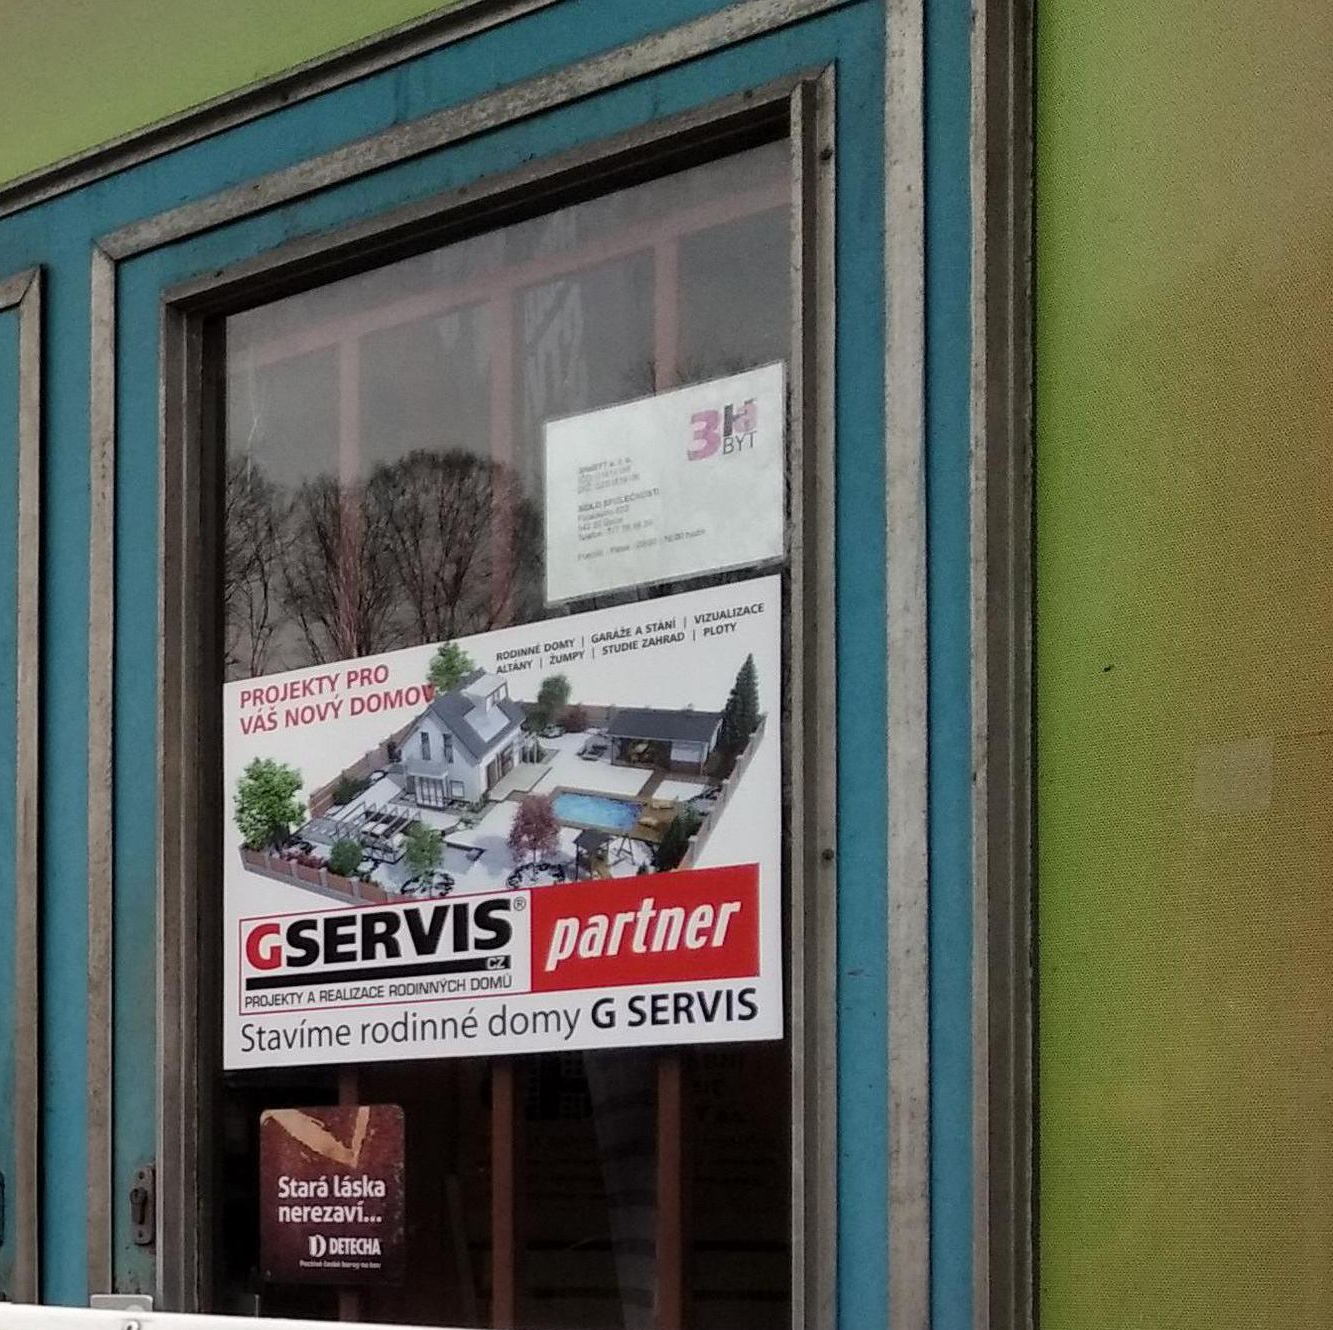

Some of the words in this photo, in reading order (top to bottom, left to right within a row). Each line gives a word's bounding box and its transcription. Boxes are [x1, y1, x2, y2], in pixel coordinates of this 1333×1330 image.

[723, 432, 758, 455] BYT
[496, 641, 541, 662] RODINNÉ
[544, 637, 576, 653] DOMY
[591, 625, 632, 644] GARÁŽE
[635, 625, 643, 636] A
[645, 617, 676, 634] STÁNÍ
[694, 602, 766, 625] VIZUALIZACE
[496, 657, 534, 675] ALTÁNY
[549, 648, 585, 665] ŽUMPY
[602, 640, 639, 656] STUDIE
[642, 631, 686, 649] ZAHRAD
[703, 622, 738, 637] PLOTY
[240, 672, 341, 709] PROJEKTY
[347, 664, 390, 690] PRO
[240, 706, 278, 735] VÁŠ
[285, 693, 344, 728] NOVÝ
[350, 683, 437, 717] DOMOV
[544, 897, 742, 972] partner
[488, 955, 507, 970] CZ
[244, 991, 303, 1009] PROJEKTY
[307, 989, 316, 1004] A
[319, 985, 385, 1003] REALIZACE
[388, 974, 466, 997] RODINNÝCH
[470, 972, 513, 990] DOMŮ
[241, 1018, 352, 1052] Stavíme
[361, 1006, 479, 1045] rodinné
[488, 1004, 582, 1041] domy
[591, 998, 616, 1030] G
[627, 987, 759, 1027] SERVIS
[278, 1175, 329, 1199] Stará
[333, 1174, 387, 1199] láska
[278, 1200, 383, 1223] nerezaví...
[329, 1237, 382, 1256] DETECHA
